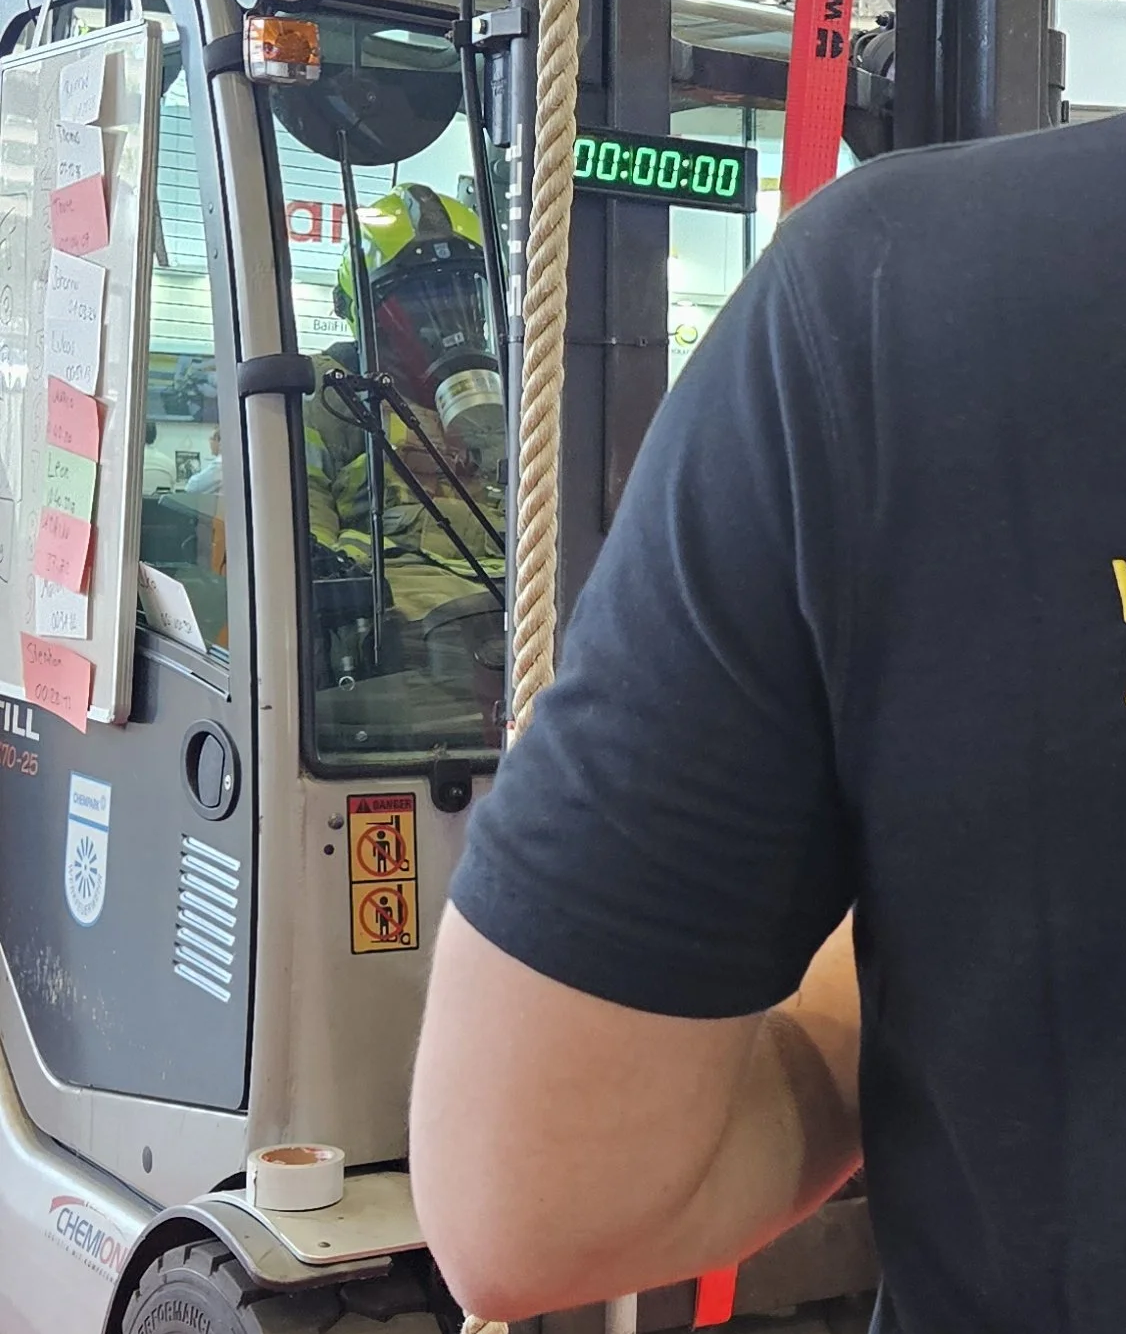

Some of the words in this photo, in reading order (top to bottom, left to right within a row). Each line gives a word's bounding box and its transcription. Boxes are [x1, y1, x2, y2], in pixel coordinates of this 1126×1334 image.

[572, 138, 740, 197] 00:00:00
[0, 741, 39, 777] 70-25
[372, 798, 412, 810] DANGER
[56, 1207, 128, 1274] CHEMION
